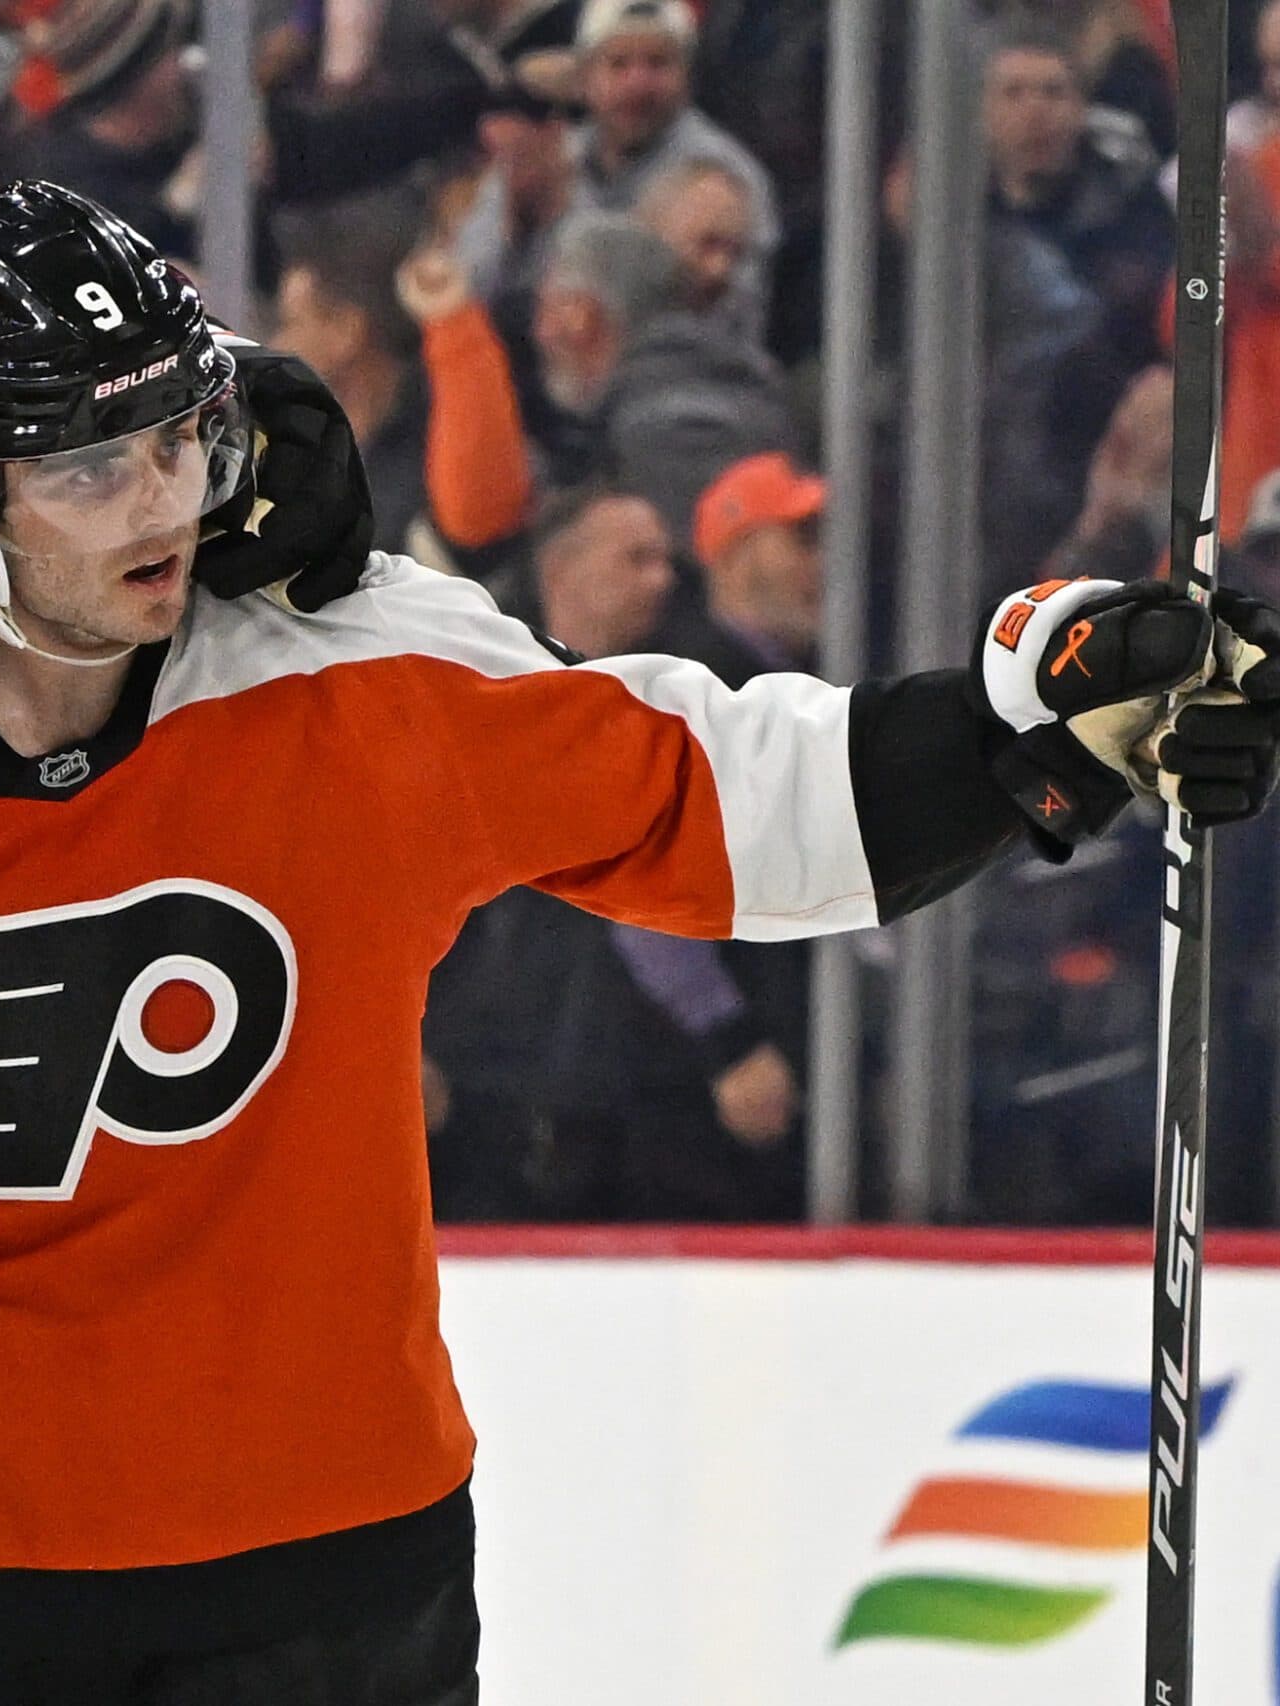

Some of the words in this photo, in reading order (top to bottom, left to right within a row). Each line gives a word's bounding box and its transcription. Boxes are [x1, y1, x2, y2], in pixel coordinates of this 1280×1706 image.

[74, 281, 124, 331] 9
[95, 354, 179, 400] BAUER
[1152, 1120, 1200, 1577] PULSE
